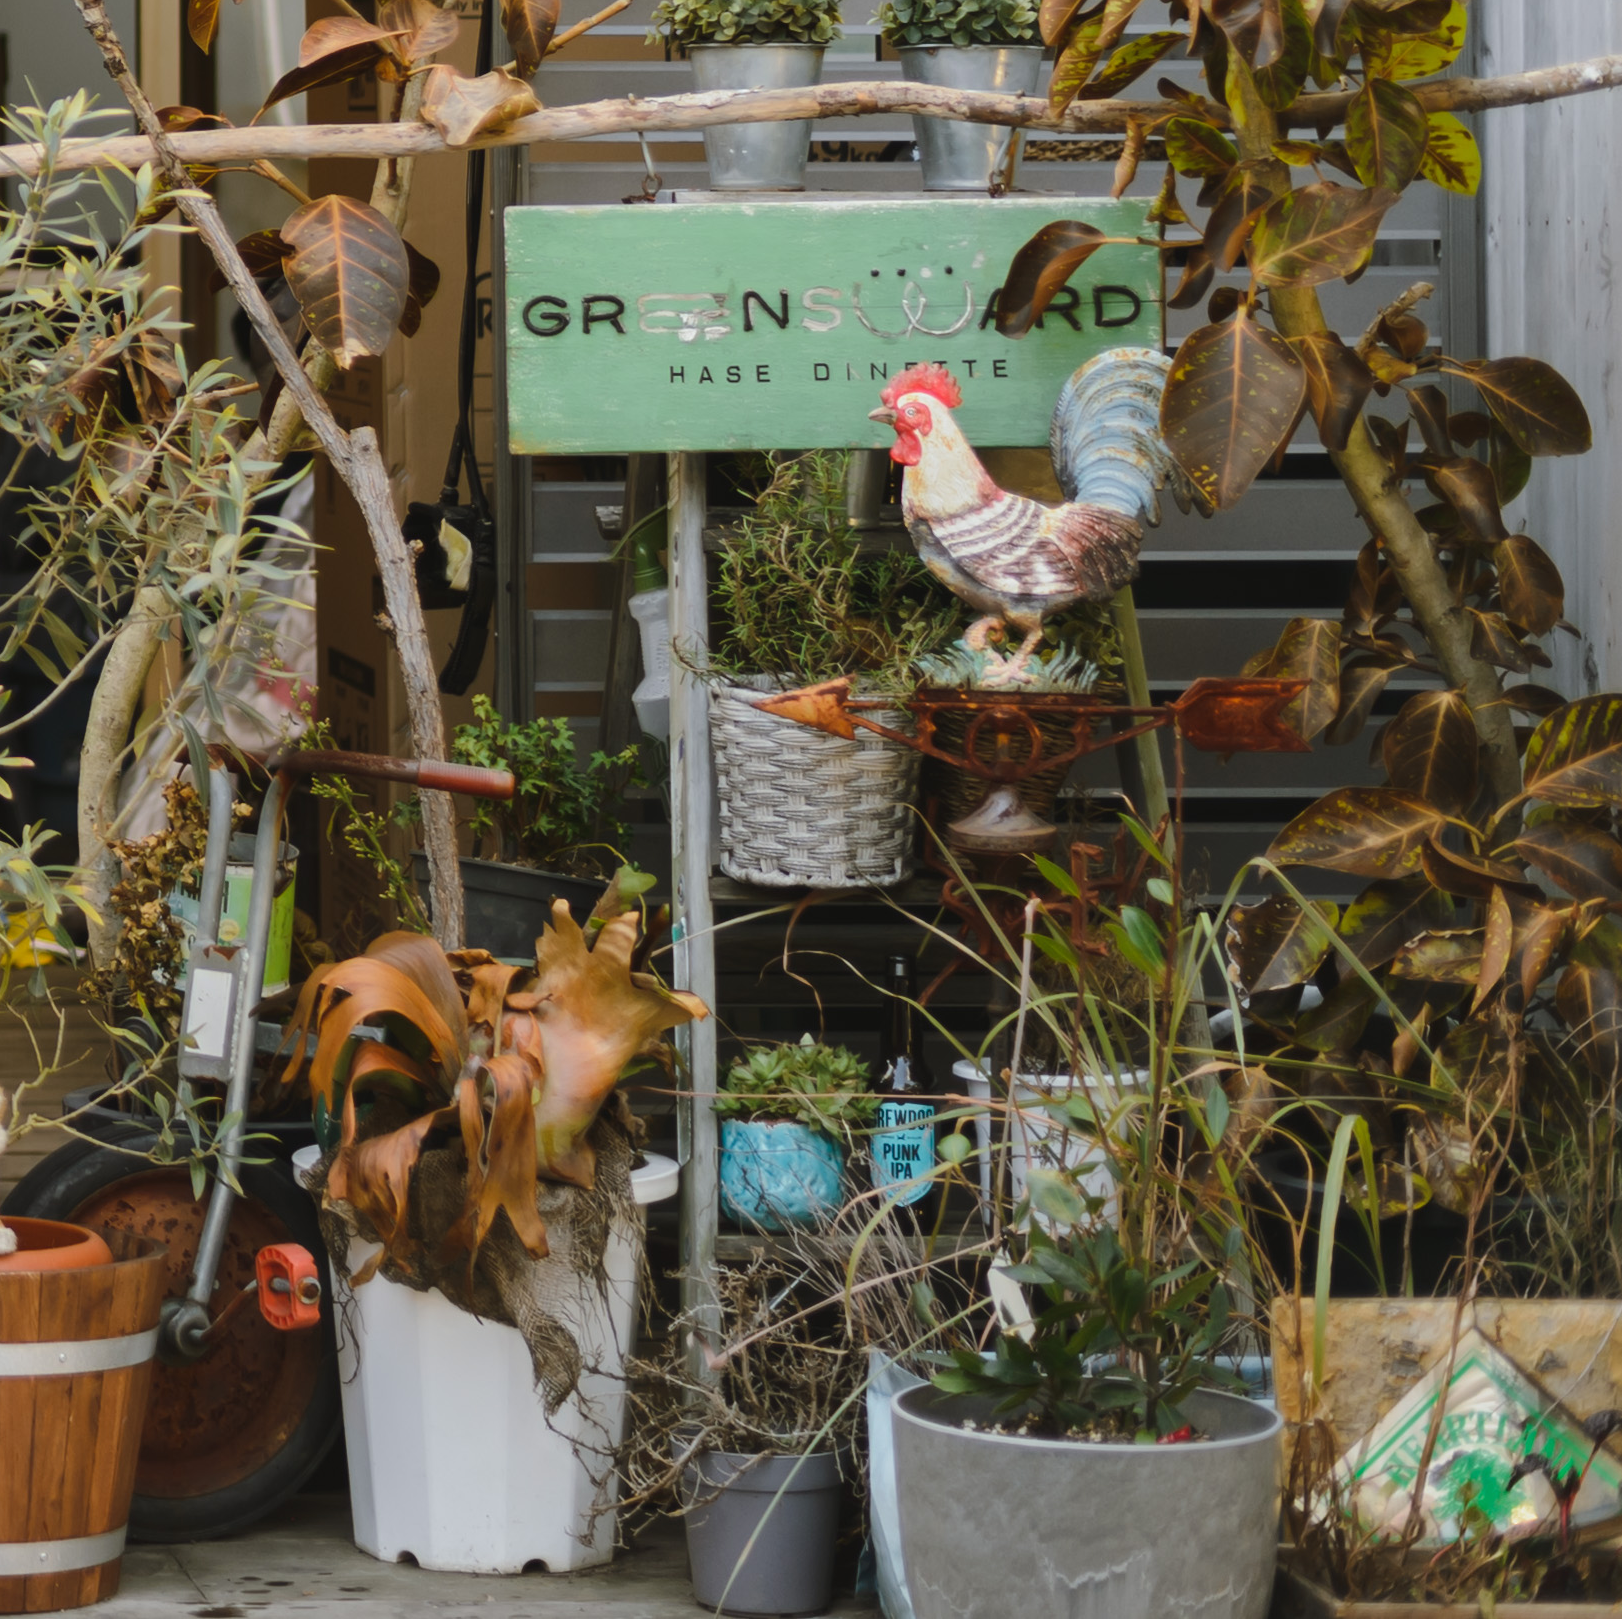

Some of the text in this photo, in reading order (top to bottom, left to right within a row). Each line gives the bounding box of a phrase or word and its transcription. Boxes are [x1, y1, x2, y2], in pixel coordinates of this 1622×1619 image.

[669, 359, 1009, 384] HASE DINTE
[877, 1109, 933, 1130] REWDO
[883, 1143, 920, 1161] PUNK
[891, 1162, 913, 1180] IPA
